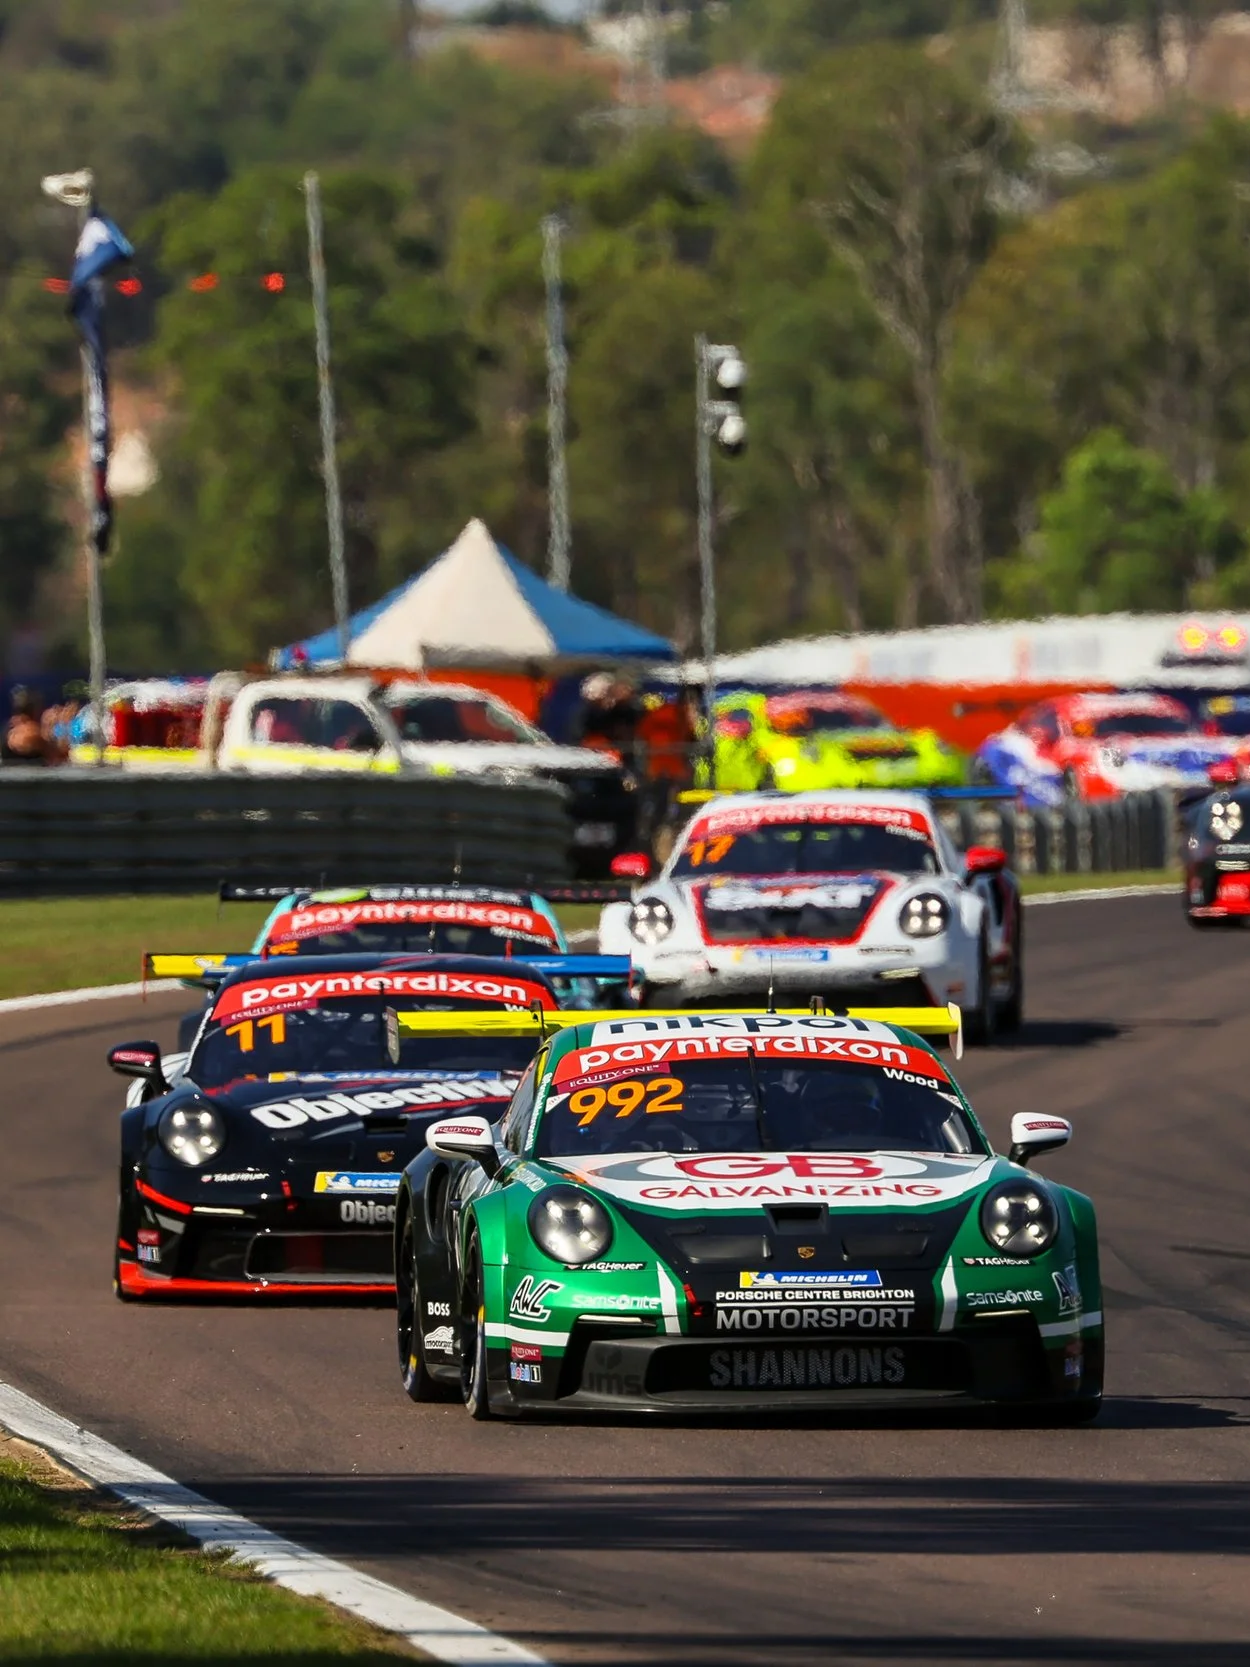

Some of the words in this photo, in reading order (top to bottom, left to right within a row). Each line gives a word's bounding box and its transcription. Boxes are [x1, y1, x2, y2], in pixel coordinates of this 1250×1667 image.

[291, 902, 533, 931] paynterdixon
[242, 974, 527, 1008] paynterdixon
[225, 1013, 285, 1052] 11
[610, 1015, 871, 1034] nikpol
[578, 1035, 909, 1074] paynterdixon
[882, 1066, 939, 1090] Wood
[250, 1079, 519, 1129] Objectiv
[569, 1077, 684, 1127] 992
[674, 1155, 884, 1179] GB
[341, 1200, 397, 1224] Objec
[780, 1274, 868, 1283] MICHELIN
[716, 1290, 783, 1301] PORSCHE
[785, 1290, 840, 1300] CENTRE
[843, 1289, 915, 1299] BRIGHTON
[427, 1301, 451, 1316] BOSS
[716, 1308, 915, 1330] MOTORSPORT
[710, 1346, 905, 1387] SHANNONS
